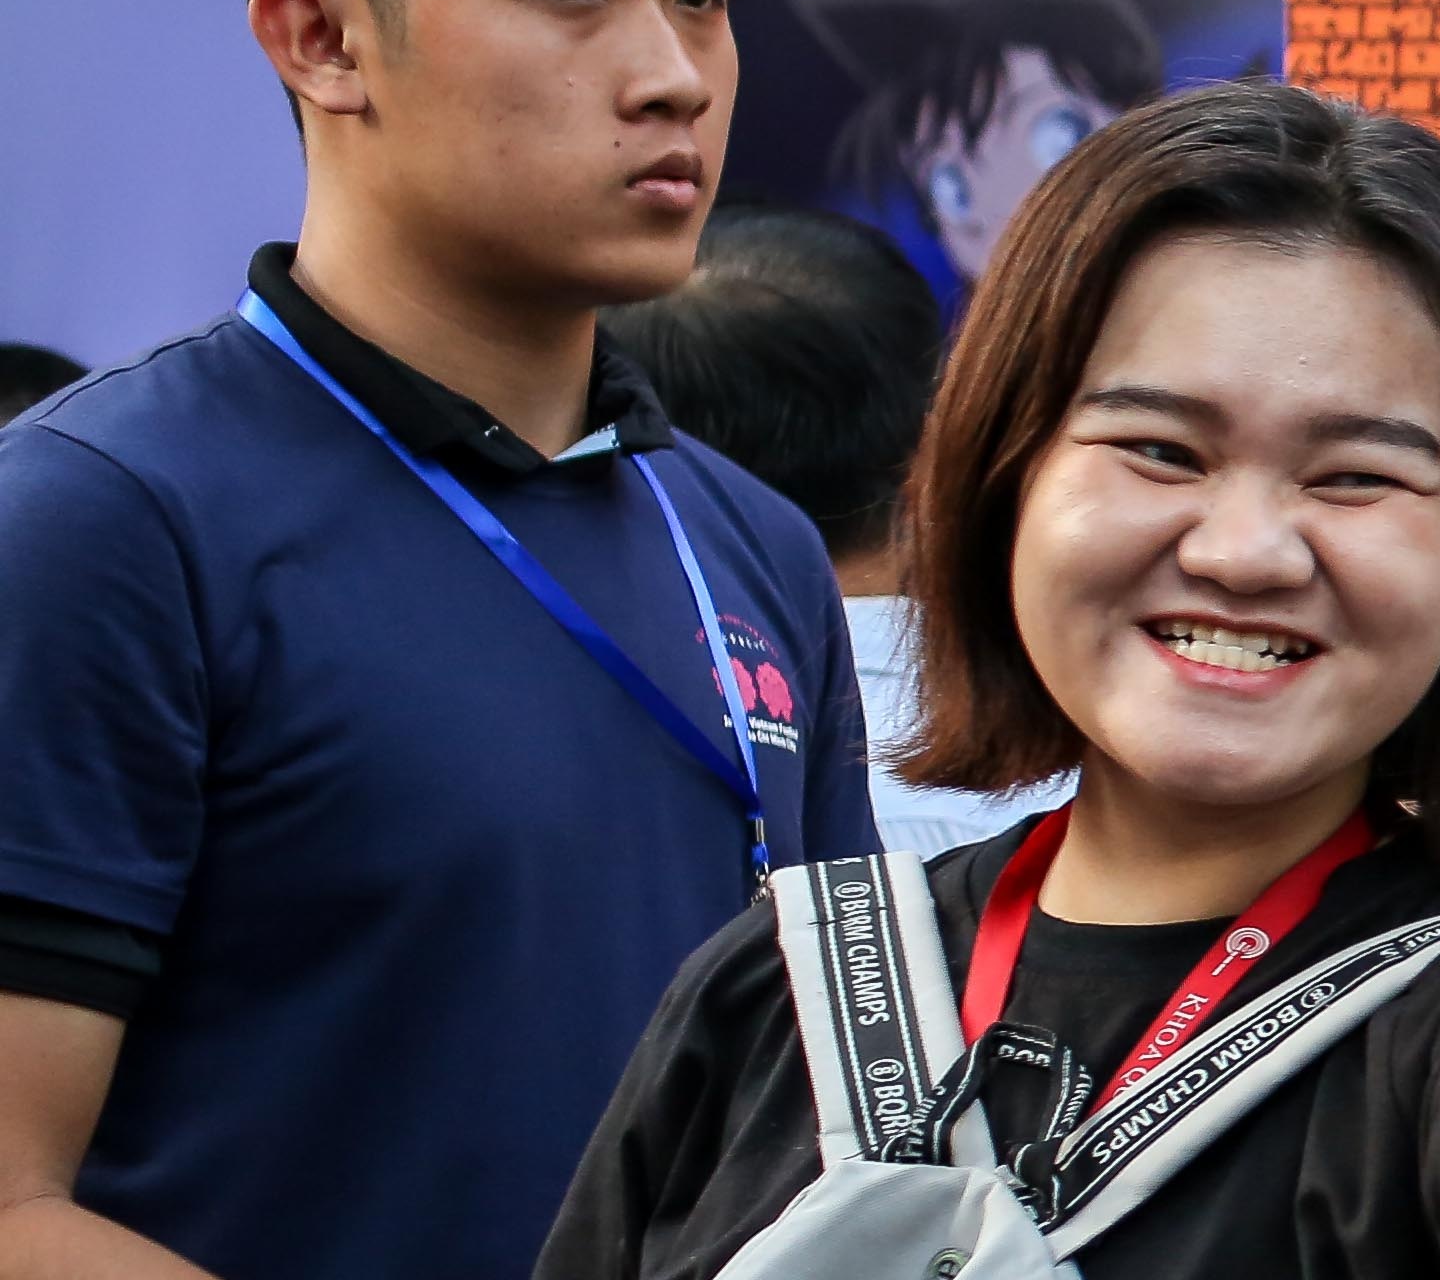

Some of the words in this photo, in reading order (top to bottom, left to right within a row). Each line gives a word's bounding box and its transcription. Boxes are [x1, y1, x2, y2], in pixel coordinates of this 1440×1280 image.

[847, 943, 890, 1027] CHAMPS
[1137, 992, 1209, 1067] KHOA
[1213, 1005, 1301, 1071] BQRM
[1092, 1068, 1210, 1165] CHAMPS
